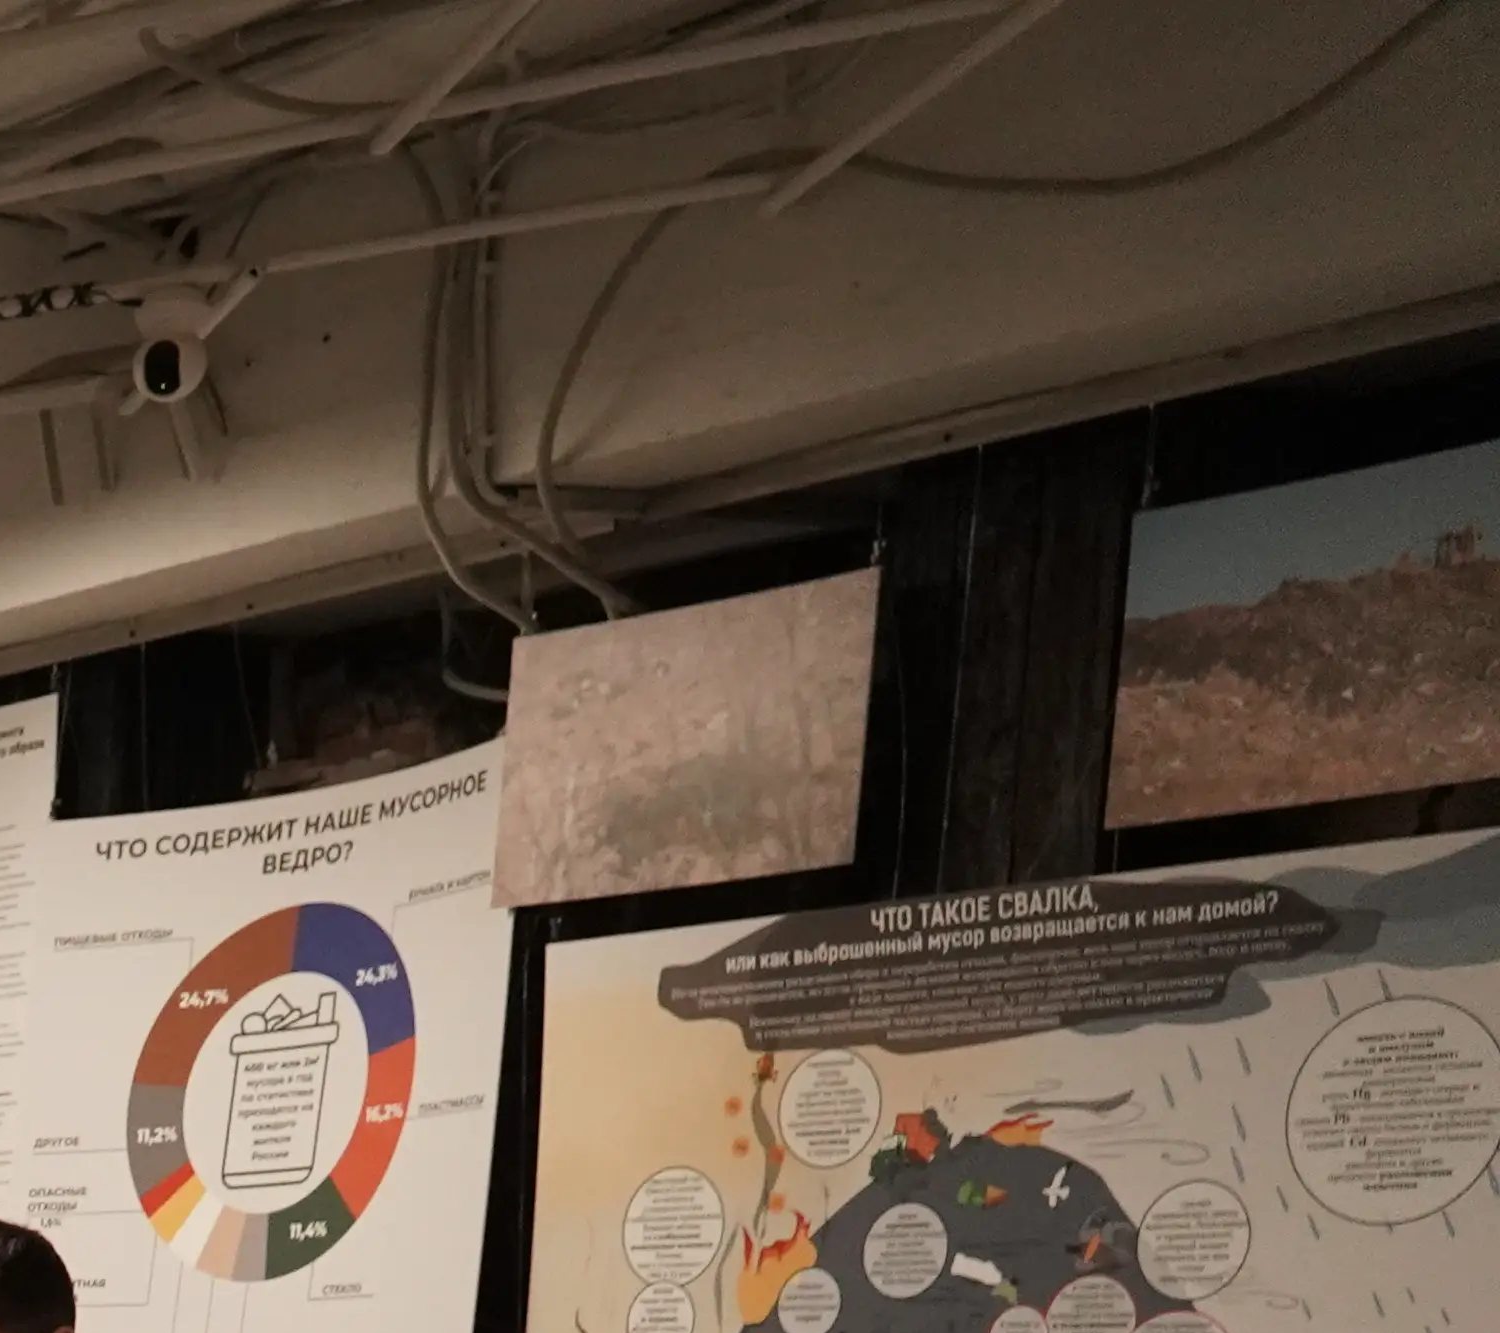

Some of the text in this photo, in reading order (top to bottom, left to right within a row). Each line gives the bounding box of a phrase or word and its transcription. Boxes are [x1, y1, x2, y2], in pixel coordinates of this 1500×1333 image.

[96, 769, 488, 860] ЧТО СОДЕРЖИТ НАШЕ МУСОРНОЕ
[262, 840, 354, 874] ВЕДРО?
[870, 884, 1100, 934] ЧТО ТАКОЕ СВАЛКА,
[725, 889, 1279, 974] или как выброшенный мусор возвращается к нам домой?
[33, 1136, 80, 1149] ДРУГОЕ
[136, 1125, 178, 1146] 11,2%
[28, 1186, 87, 1198] ОПАСНЫЕ
[27, 1202, 78, 1212] ОТХОДЫ
[289, 1221, 327, 1241] 11,4%
